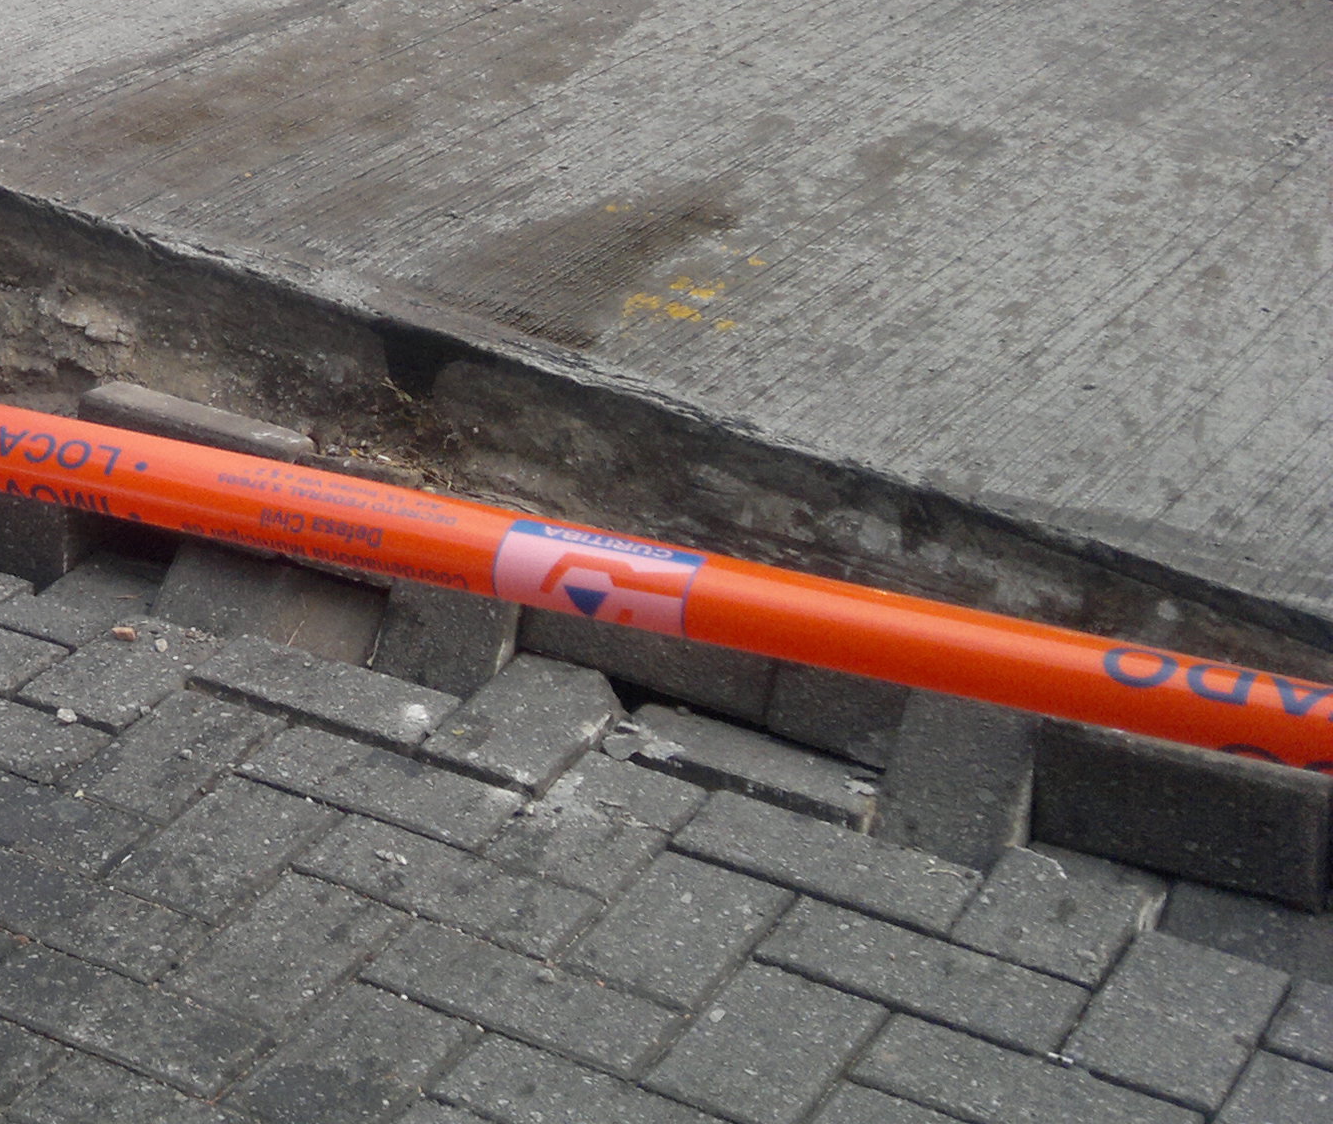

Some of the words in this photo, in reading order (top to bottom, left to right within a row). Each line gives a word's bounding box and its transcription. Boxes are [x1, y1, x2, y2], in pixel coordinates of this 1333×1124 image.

[289, 485, 367, 510] FEDERAL
[259, 508, 306, 534] Civil
[371, 501, 457, 526] DECRETO
[310, 517, 383, 548] Defesa
[543, 525, 674, 559] CURITIBA
[1103, 647, 1333, 723] ADO
